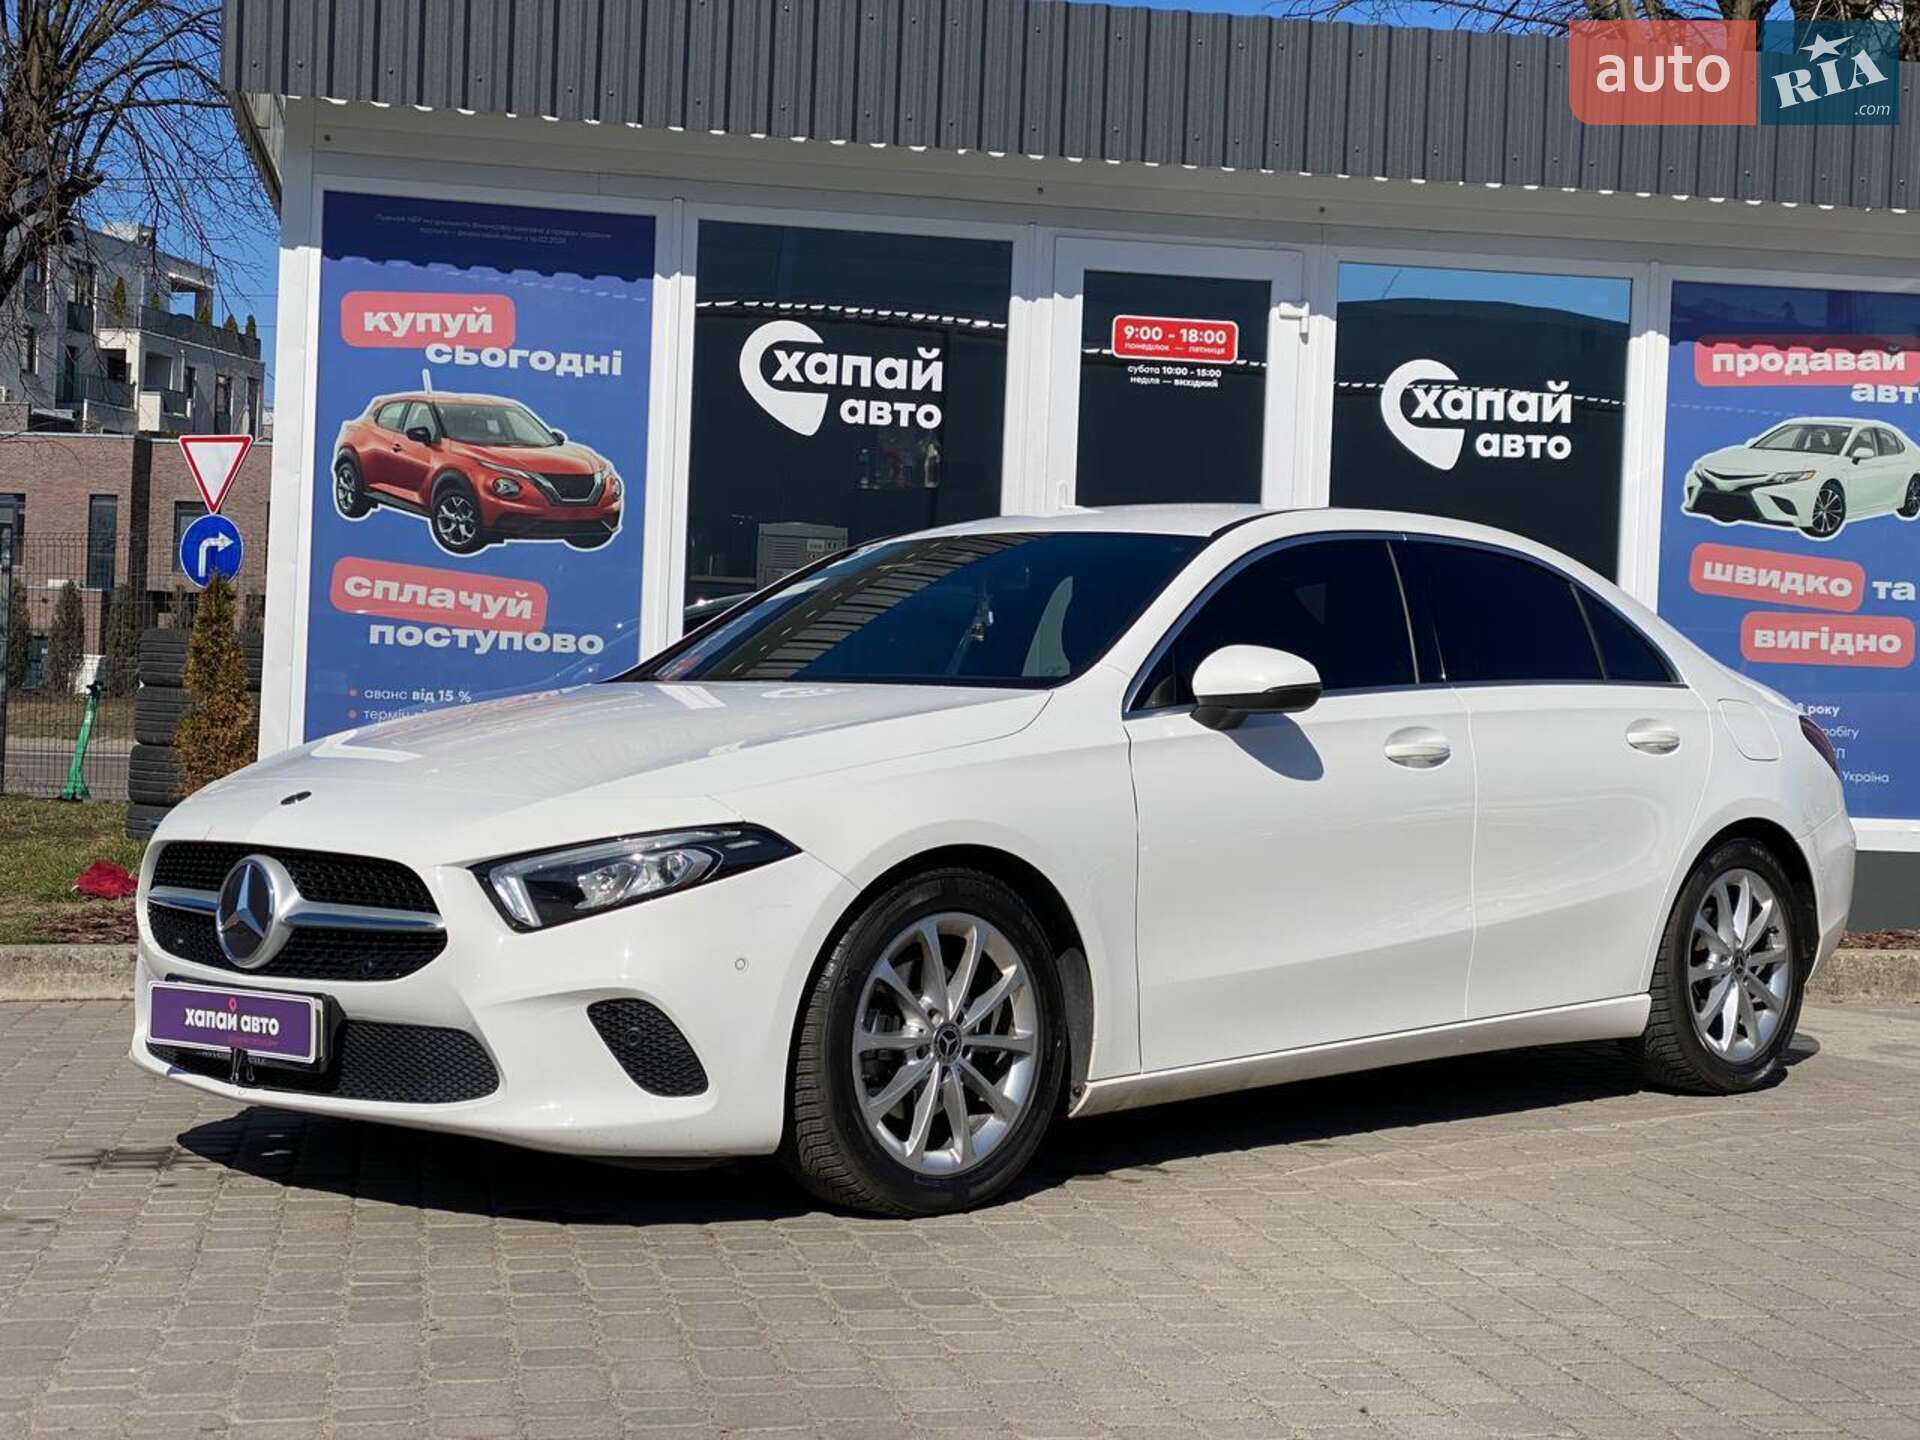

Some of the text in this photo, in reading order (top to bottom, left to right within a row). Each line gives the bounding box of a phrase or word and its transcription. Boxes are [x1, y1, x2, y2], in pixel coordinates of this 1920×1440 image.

[364, 306, 493, 338] купуй
[1123, 325, 1163, 341] 9:00
[1179, 328, 1227, 345] 18:00
[424, 343, 623, 378] сьогодні
[772, 347, 943, 392] хапай
[1127, 364, 1160, 375] субота
[1162, 366, 1188, 375] 10:00
[1196, 368, 1222, 378] 15:00
[1712, 345, 1905, 377] продавай
[1411, 380, 1572, 424] хапай
[1851, 383, 1920, 405] авт
[840, 398, 942, 430] авто
[1475, 432, 1572, 460] авто
[1703, 561, 1916, 601] швидко та
[344, 575, 533, 620] сплачуй
[368, 624, 604, 656] поступово
[1754, 626, 1902, 656] вигідно
[364, 687, 472, 703] аванс від 15 %
[1808, 705, 1840, 718] року
[1842, 771, 1889, 785] Україна
[240, 1014, 279, 1035] авто
